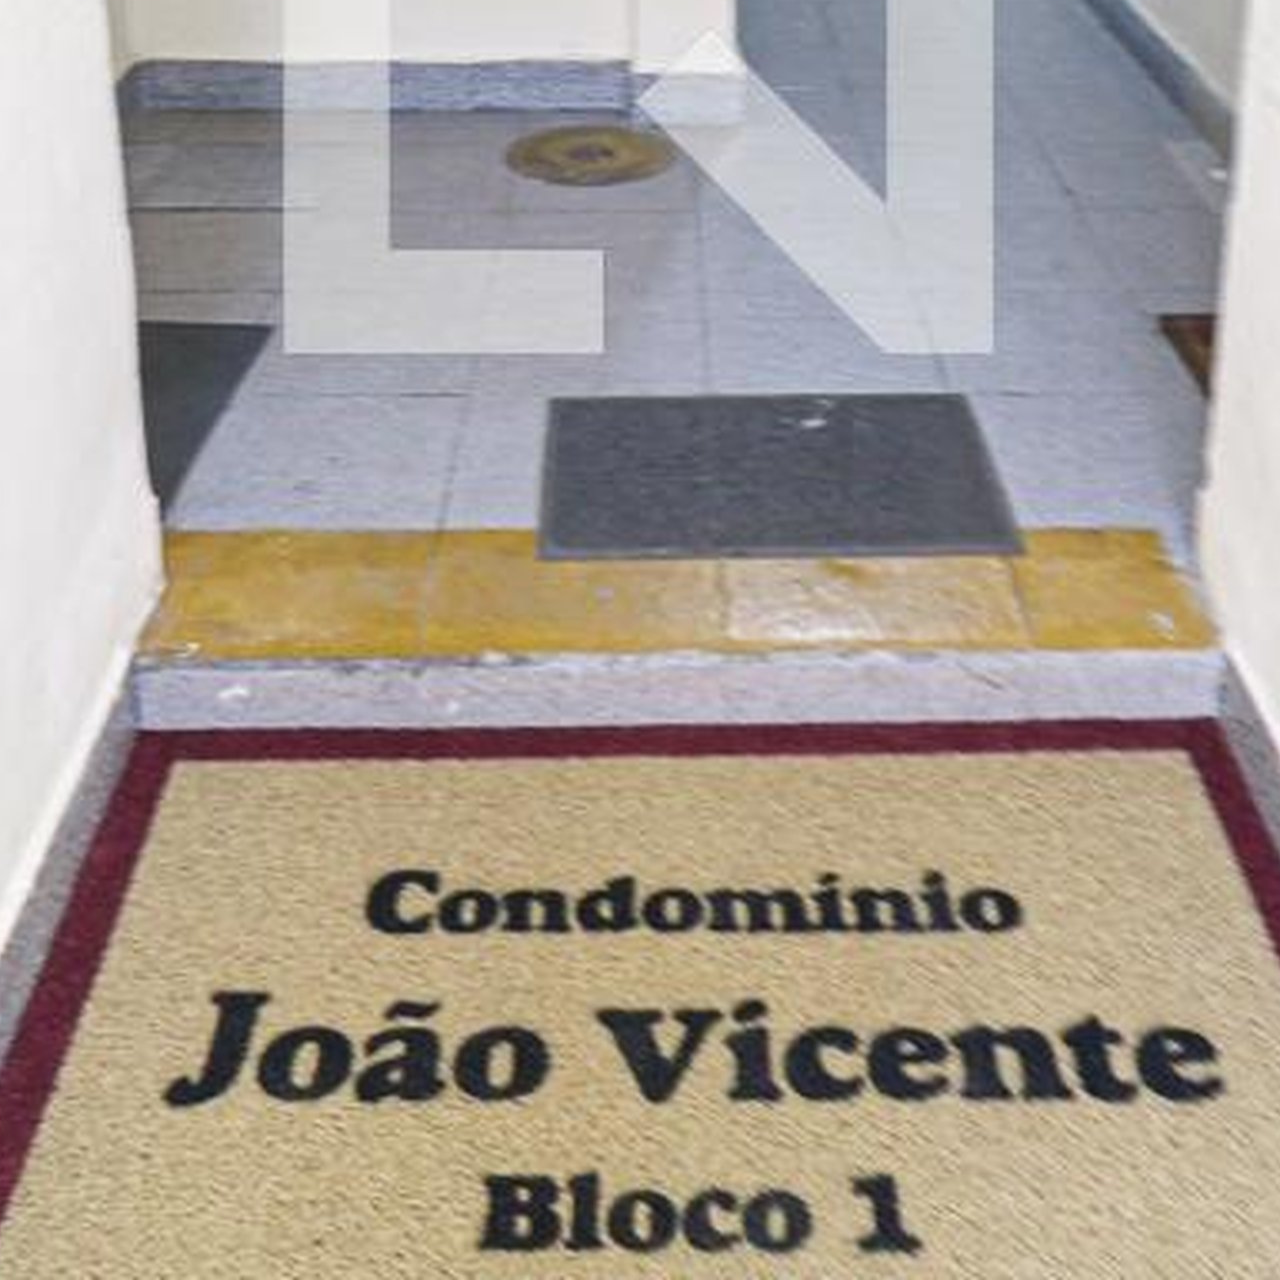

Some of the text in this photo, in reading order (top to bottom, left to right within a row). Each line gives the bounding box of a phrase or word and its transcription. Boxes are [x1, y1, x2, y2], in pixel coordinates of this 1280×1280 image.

[160, 989, 1225, 1109] João Vicente
[476, 1170, 923, 1257] Bloco 1
